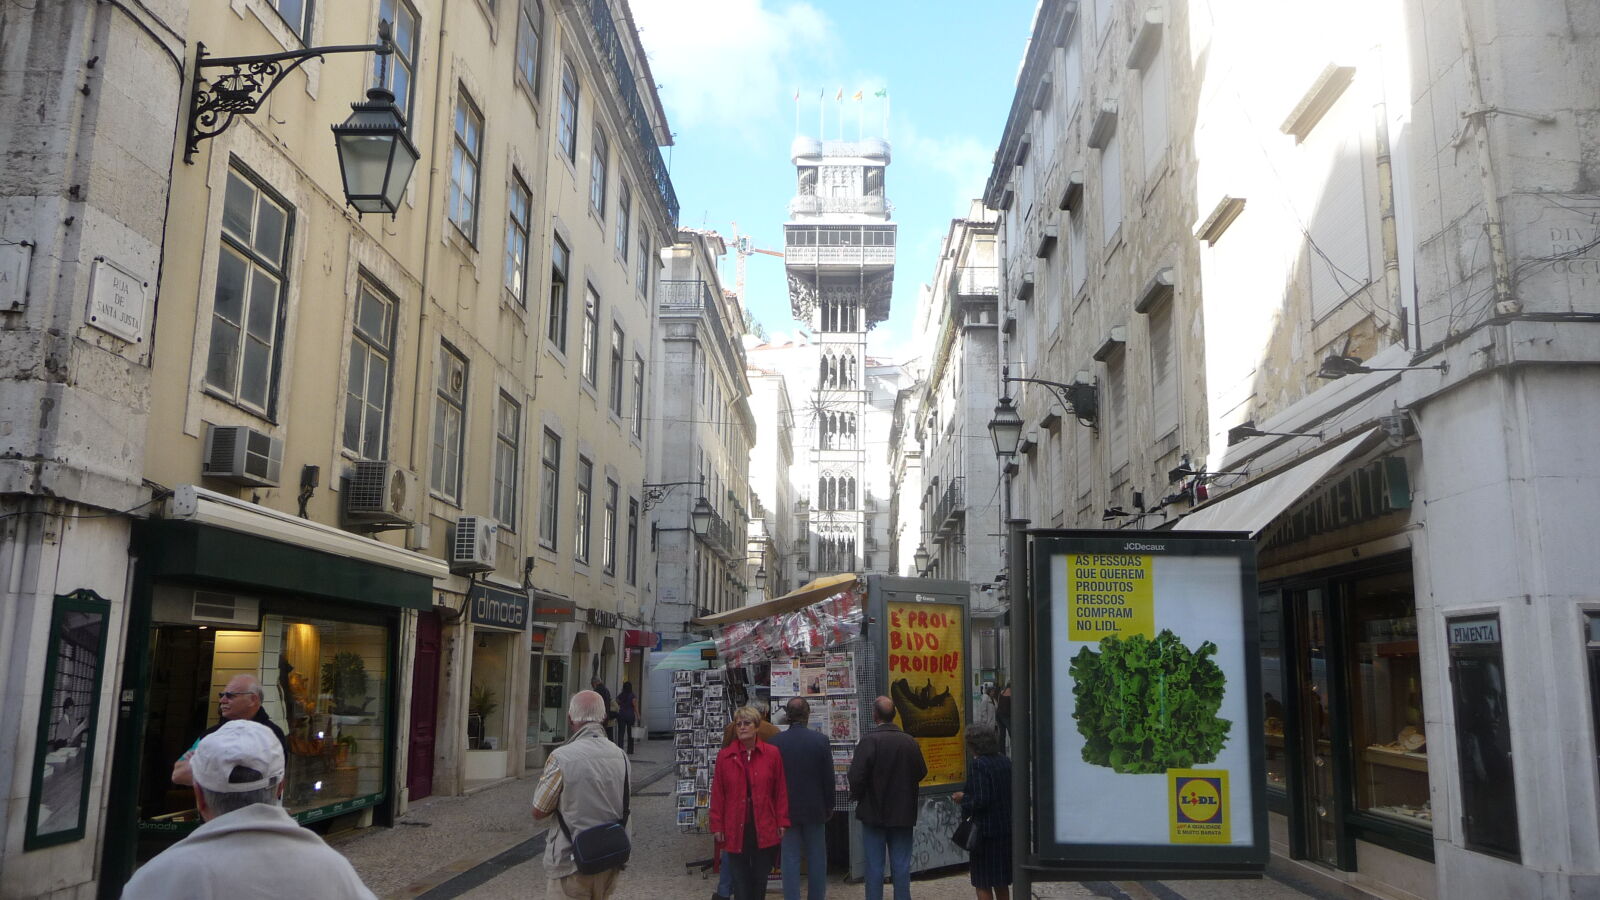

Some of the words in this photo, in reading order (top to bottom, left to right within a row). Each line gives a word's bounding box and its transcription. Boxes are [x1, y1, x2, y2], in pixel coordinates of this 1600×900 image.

[113, 277, 129, 295] RUA
[115, 293, 125, 307] DE
[97, 301, 117, 319] SANTA
[120, 312, 139, 329] JUSTA
[1123, 542, 1165, 551] JCDecaux
[1075, 555, 1090, 566] AS
[1093, 555, 1142, 567] PESSOAS
[1075, 568, 1097, 579] QUE
[1100, 568, 1144, 579] QUEREM
[1076, 581, 1134, 592] PRODUTOS
[477, 583, 522, 625] dimoda
[1076, 594, 1125, 605] FRESCOS
[1076, 607, 1133, 618] COMPRAM
[1077, 620, 1092, 631] NO
[1095, 620, 1122, 631] LIDL.
[1454, 625, 1494, 642] PIMENTA
[890, 630, 939, 651] BIDO
